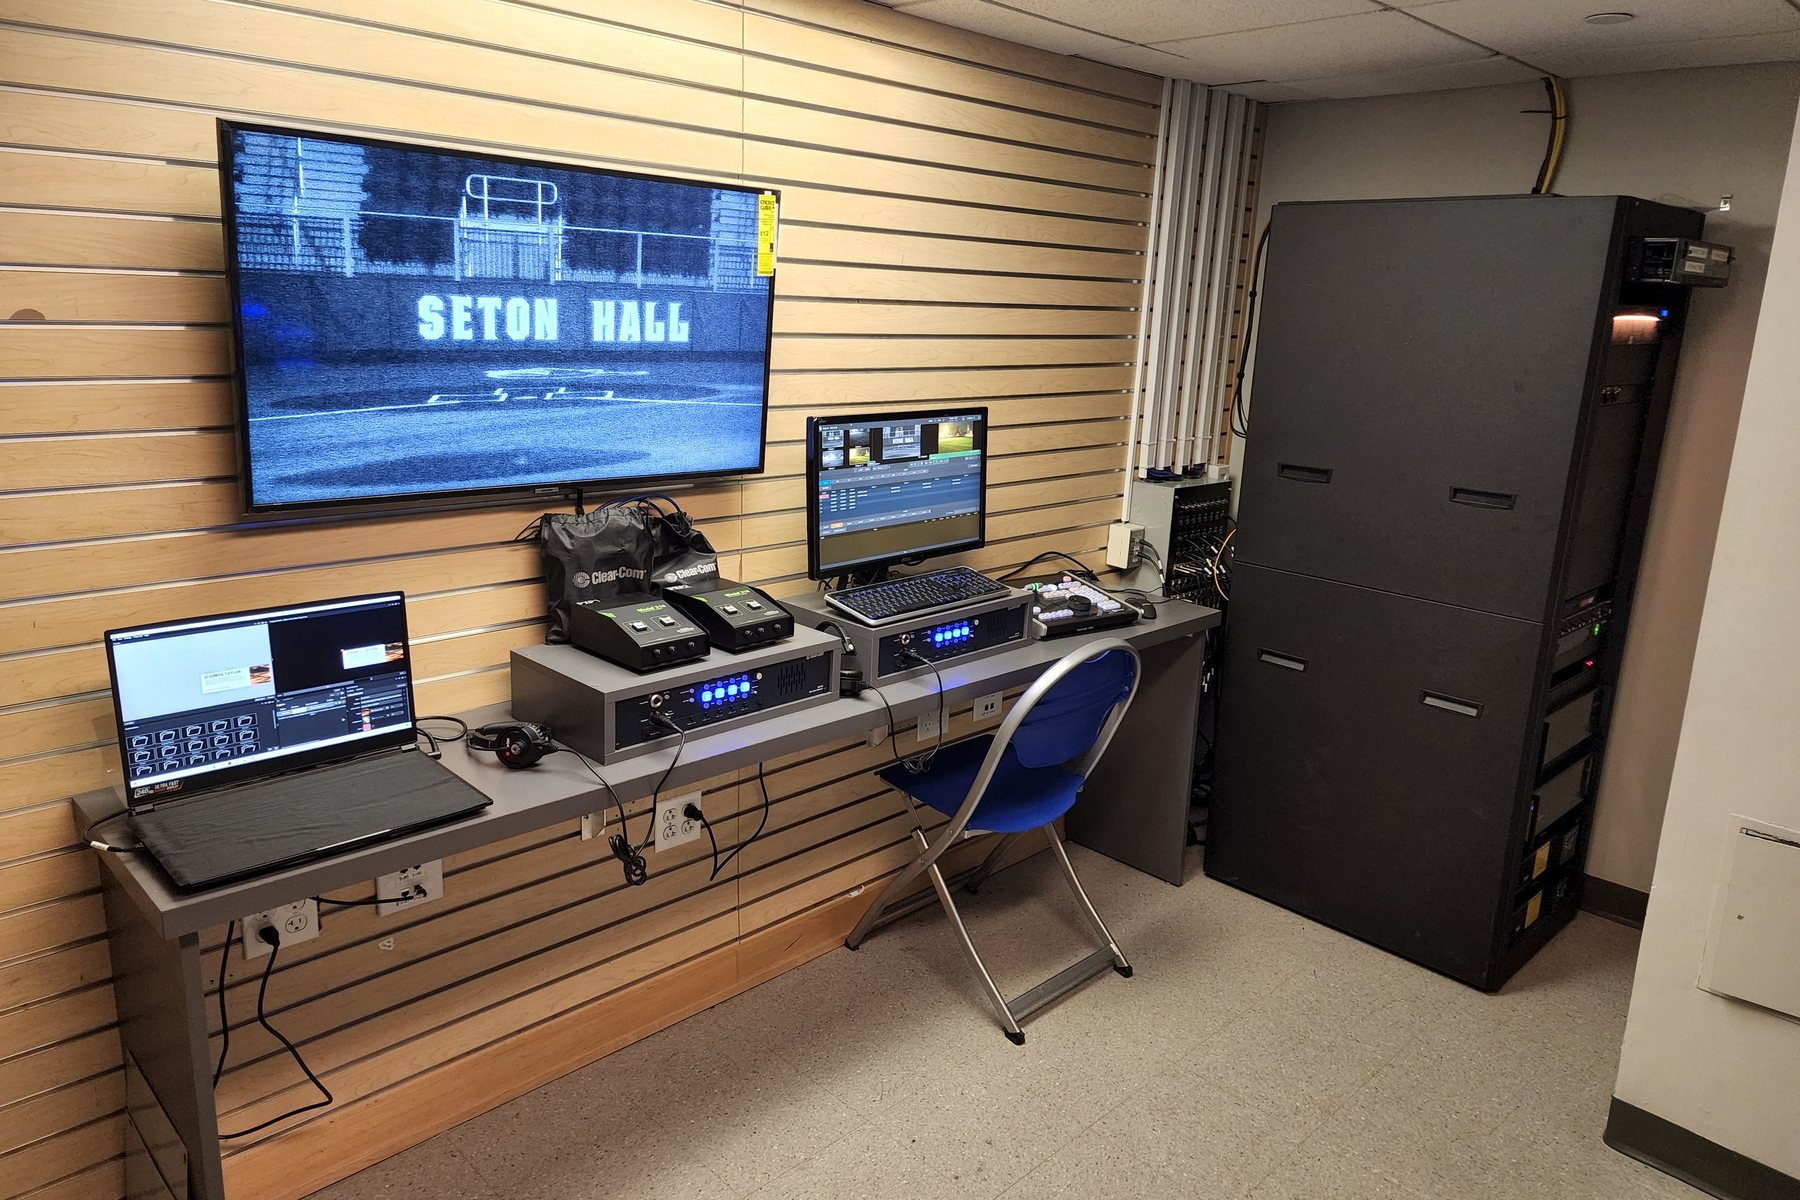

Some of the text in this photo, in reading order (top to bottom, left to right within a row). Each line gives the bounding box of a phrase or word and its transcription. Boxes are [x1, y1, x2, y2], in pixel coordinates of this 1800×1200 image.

[418, 295, 689, 341] SETON HALL
[591, 566, 644, 585] Clear-Com
[676, 563, 716, 578] Clear-Com
